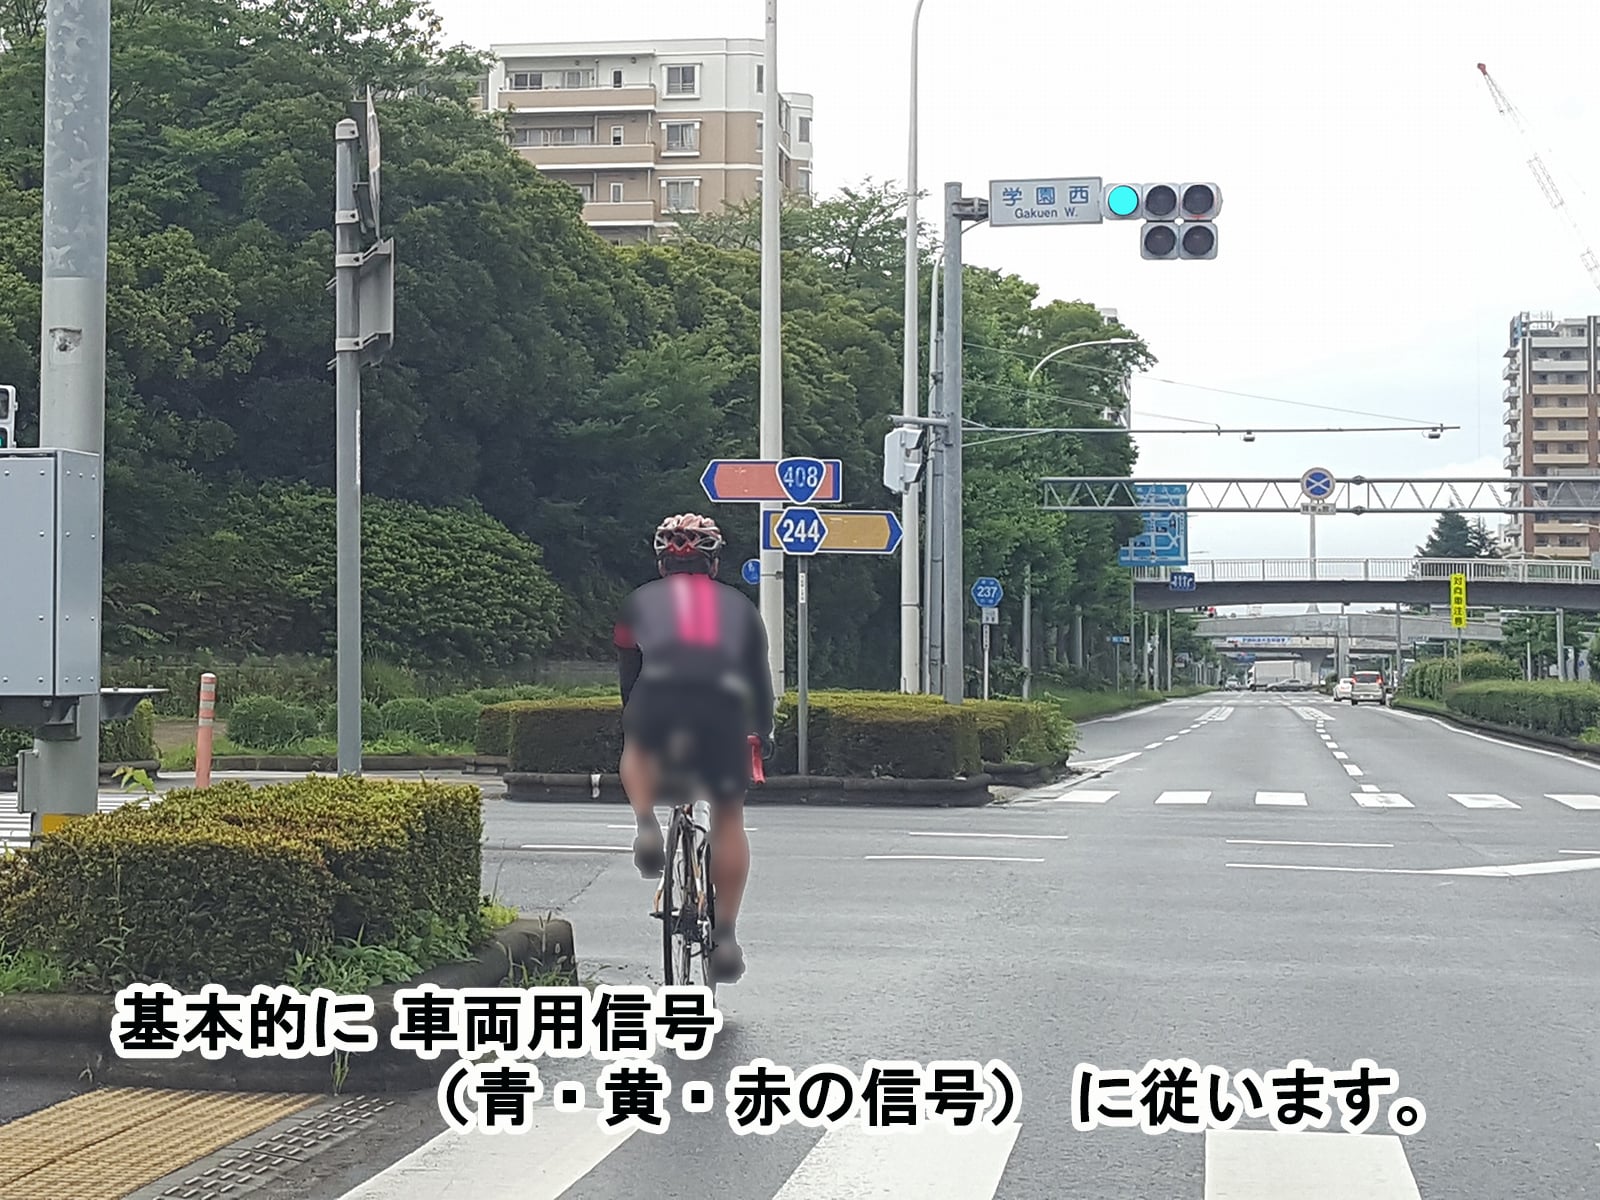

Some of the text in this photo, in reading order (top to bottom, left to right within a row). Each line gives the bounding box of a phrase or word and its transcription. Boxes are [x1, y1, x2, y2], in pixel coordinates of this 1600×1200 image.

[1002, 186, 1090, 206] 学園西
[1014, 207, 1079, 219] Gakuen W.
[782, 466, 818, 488] 408
[782, 518, 820, 543] 244
[976, 585, 998, 599] 237
